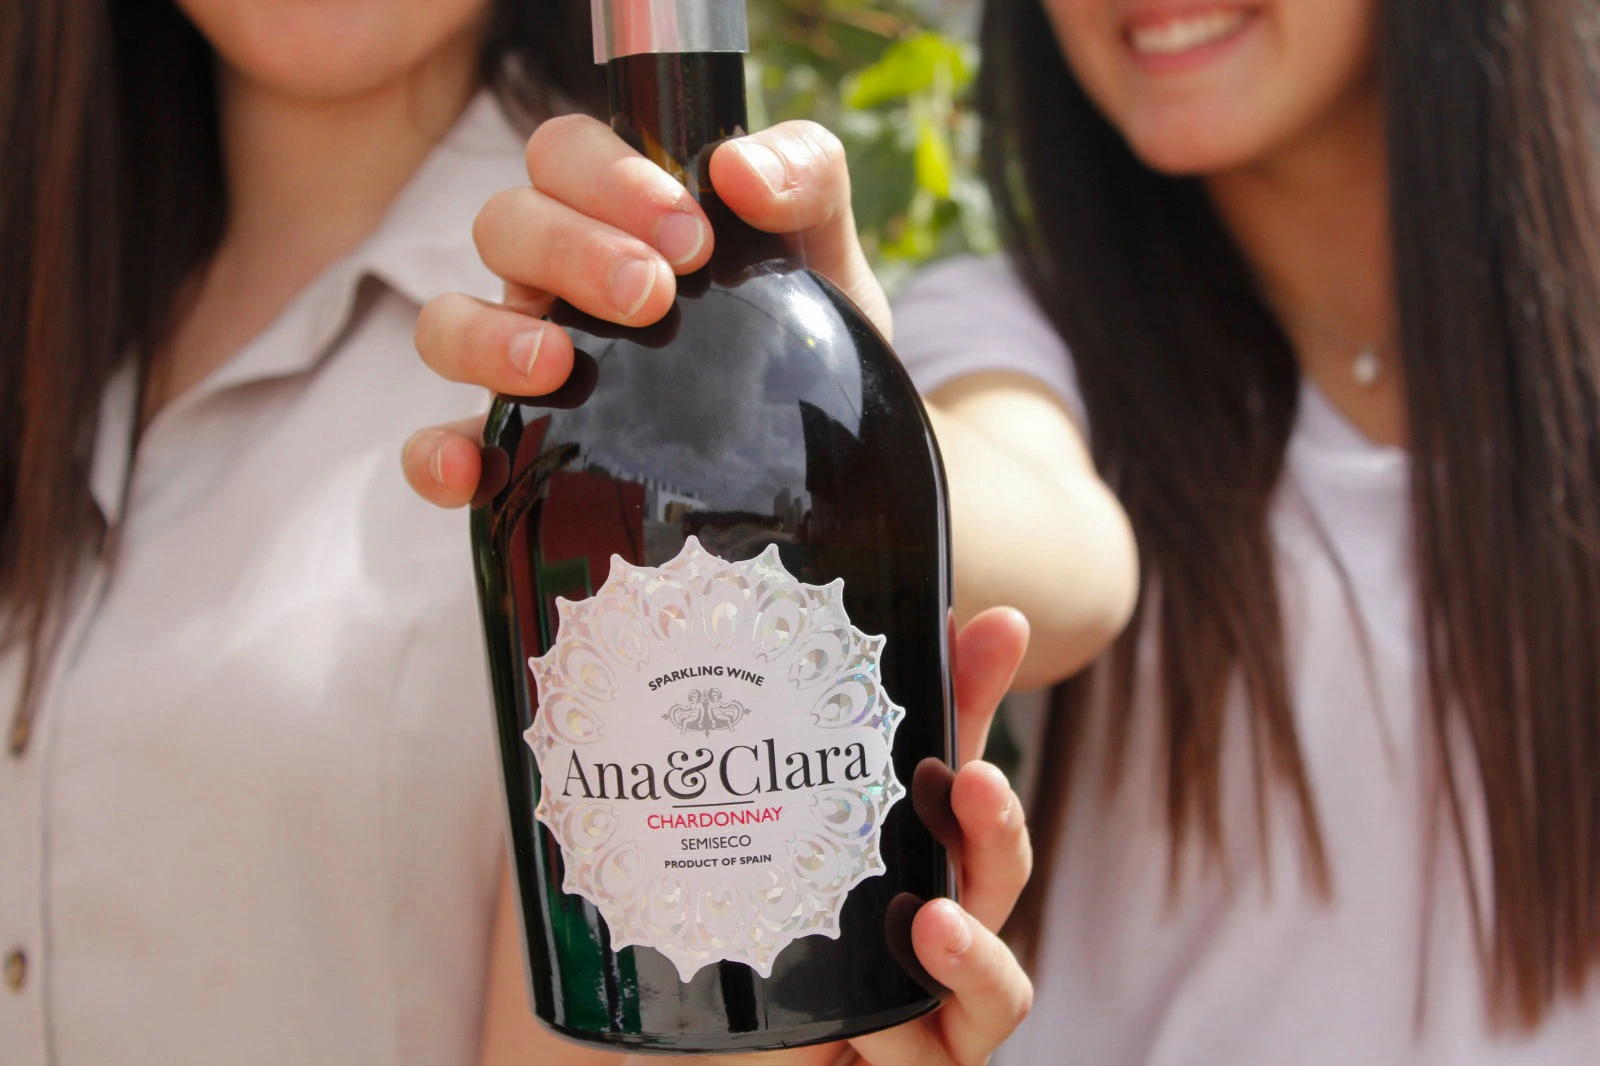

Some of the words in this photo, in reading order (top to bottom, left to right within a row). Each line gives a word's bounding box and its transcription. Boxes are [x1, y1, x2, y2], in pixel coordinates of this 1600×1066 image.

[648, 665, 724, 691] SPARKLING
[727, 666, 765, 687] WINE
[647, 806, 783, 830] CHARDONNAY
[680, 835, 752, 851] SEMISECO
[664, 857, 719, 869] PRODUCT
[721, 856, 737, 867] OF
[739, 854, 772, 866] SPAIN
